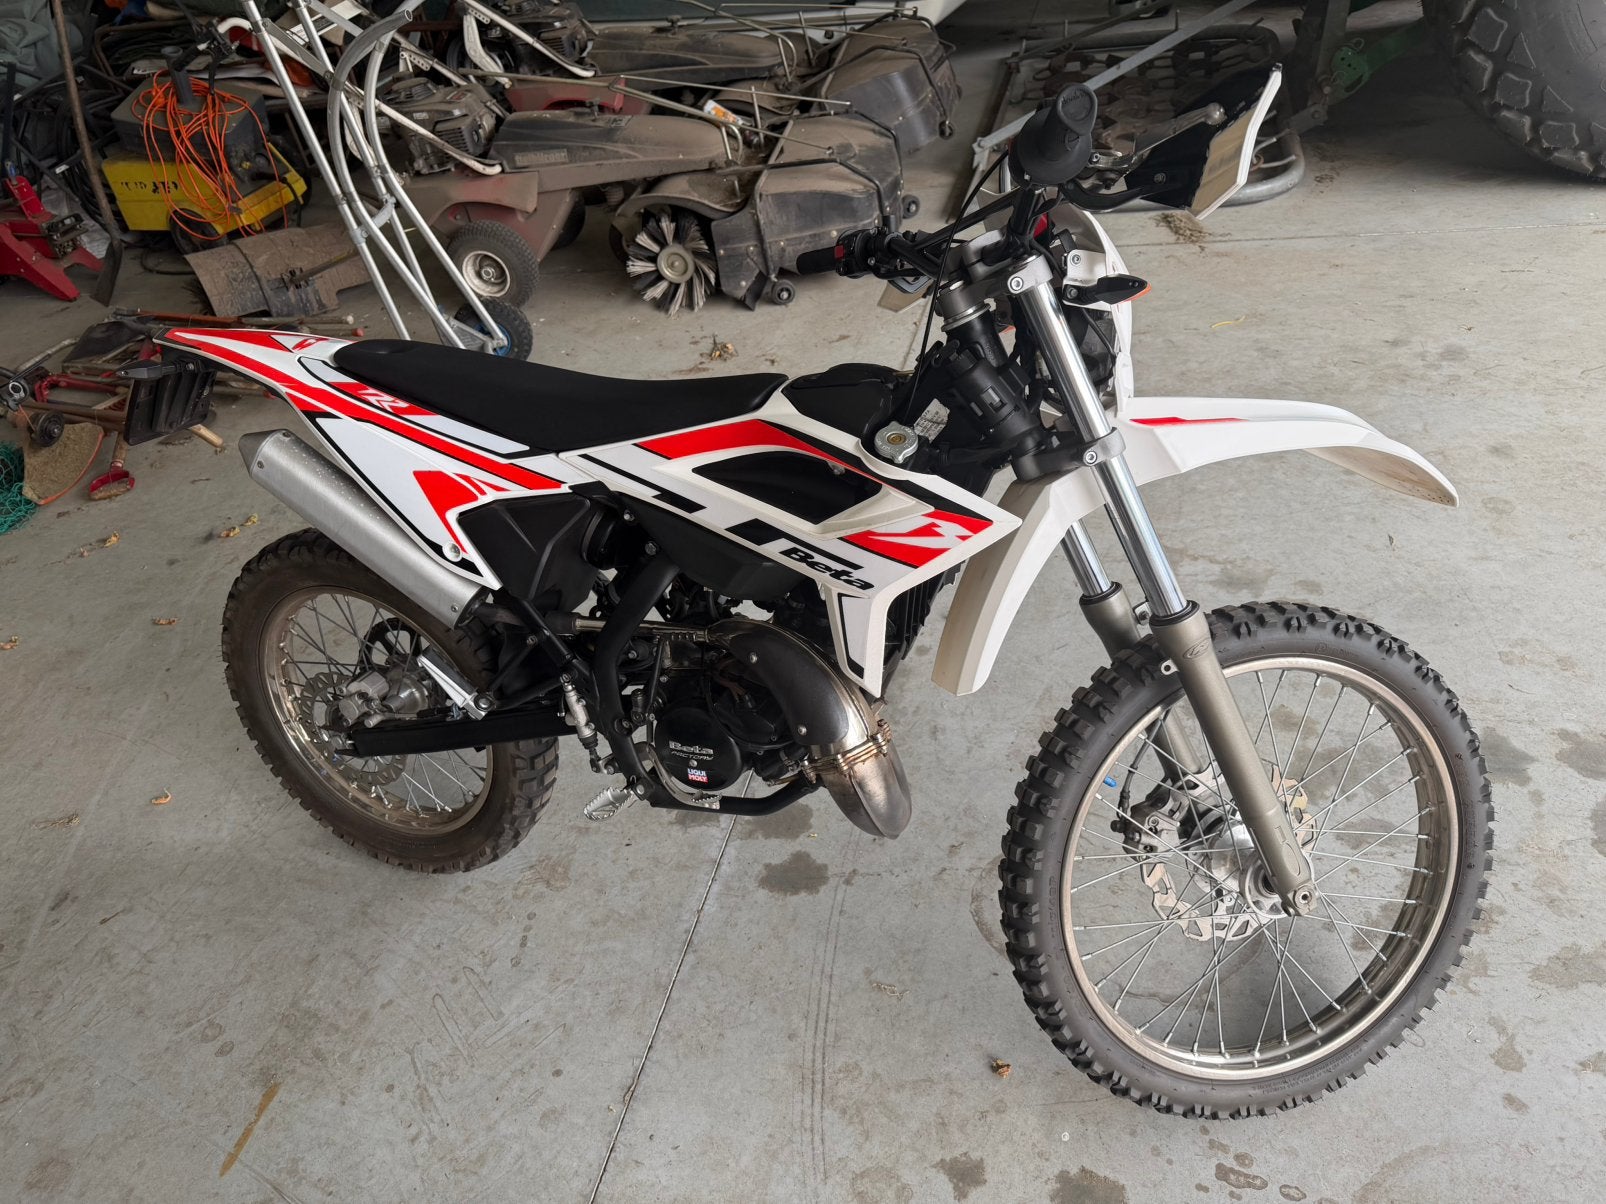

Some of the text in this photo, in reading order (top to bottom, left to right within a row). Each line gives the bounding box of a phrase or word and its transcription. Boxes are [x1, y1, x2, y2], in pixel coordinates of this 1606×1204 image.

[778, 546, 875, 590] Beta
[669, 740, 713, 754] Beta
[687, 768, 707, 777] LIQUI
[688, 774, 708, 783] MOLY
